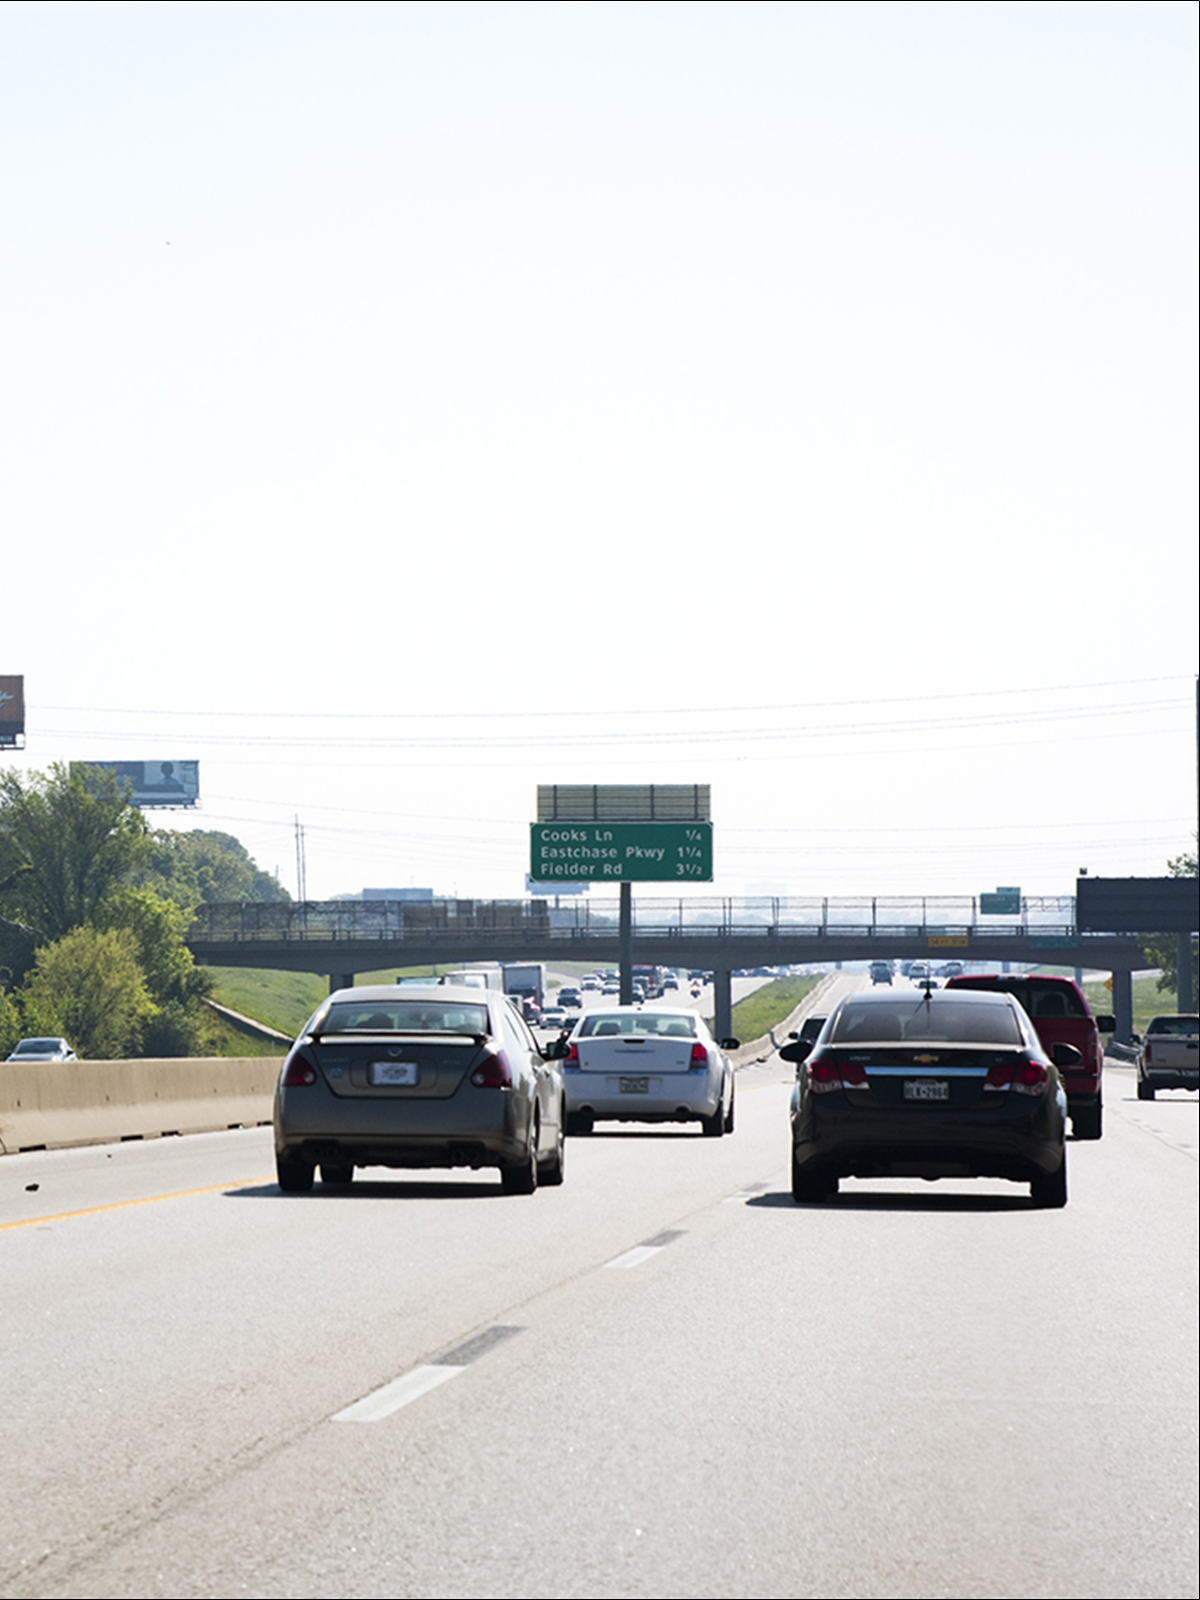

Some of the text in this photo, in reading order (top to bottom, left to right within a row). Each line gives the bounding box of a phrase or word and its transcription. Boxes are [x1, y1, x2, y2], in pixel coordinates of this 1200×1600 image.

[540, 829, 588, 842] Cooks
[595, 829, 613, 842] Ln
[540, 846, 618, 859] Eastchase
[625, 846, 666, 862] Pkwy
[540, 862, 596, 876] Fielder
[603, 863, 623, 876] Rd
